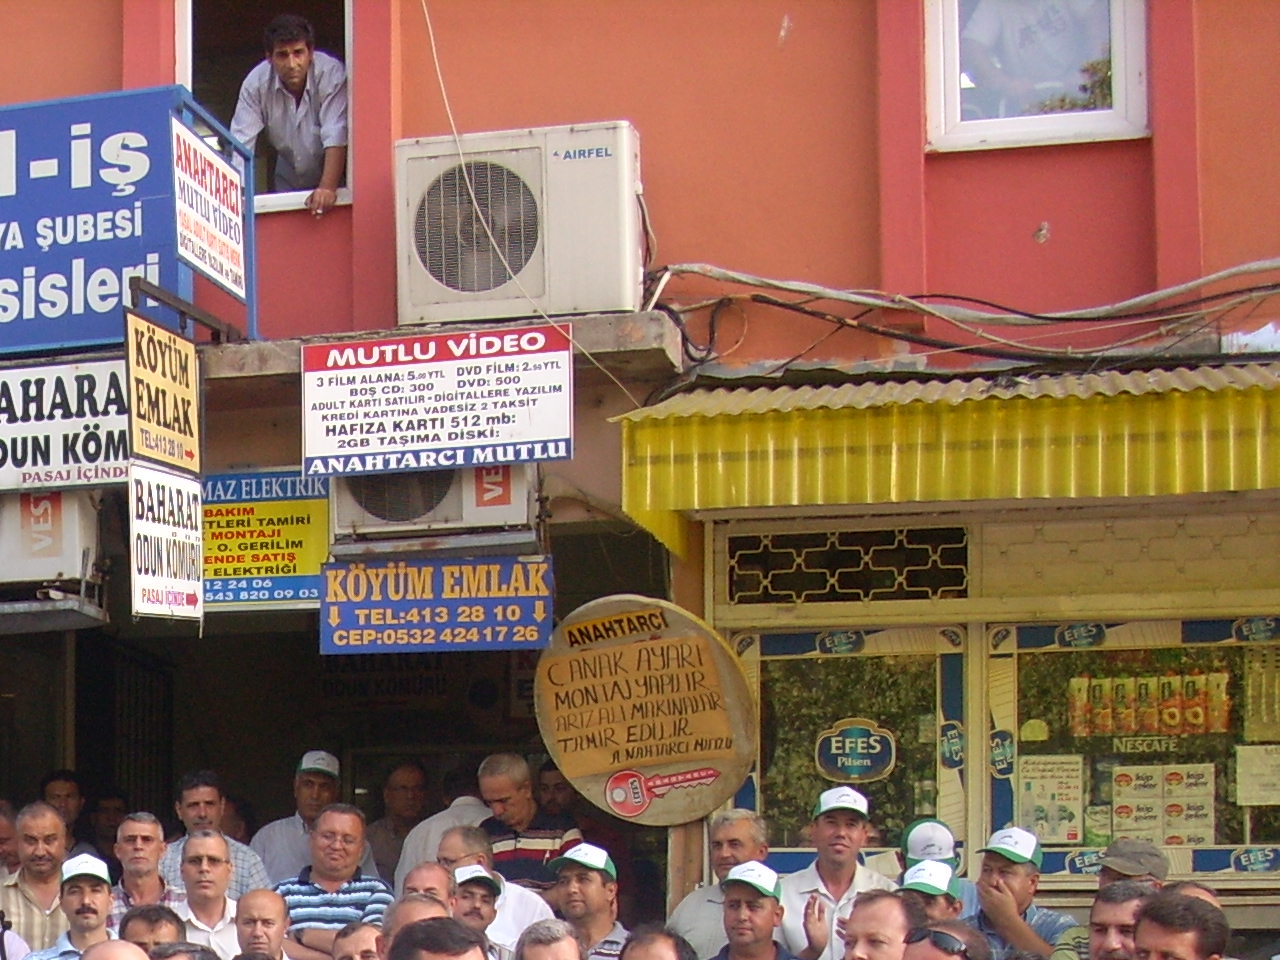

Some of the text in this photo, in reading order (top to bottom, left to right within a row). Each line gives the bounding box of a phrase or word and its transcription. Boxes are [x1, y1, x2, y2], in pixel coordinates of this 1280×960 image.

[562, 147, 612, 160] AIRFEL
[175, 133, 240, 218] ANAHTARCI
[36, 201, 142, 251] ŞUBESİ
[134, 324, 190, 389] KÖYÜM
[326, 332, 546, 368] MUTLU VİDEO
[316, 377, 324, 388] 3
[328, 372, 356, 387] FİLM
[457, 365, 482, 377] DVD
[311, 401, 346, 412] ADULT
[349, 397, 382, 409] KARTI
[384, 394, 426, 407] SATILIR
[515, 384, 563, 396] YAZILIM
[350, 387, 377, 399] BOŞ
[409, 383, 435, 393] 300
[134, 376, 194, 438] EMLAK
[321, 398, 538, 422] KREDİ KARTINA VADESİZ 2 TAKSİT
[325, 422, 387, 437] HAFIZA
[393, 418, 445, 433] KARTI
[450, 415, 482, 429] 512
[337, 437, 371, 449] 2GB
[376, 433, 442, 447] TAŞIMA
[308, 442, 567, 475] ANAHTARCI MUTLU
[22, 469, 71, 484] PASAJ
[134, 478, 200, 532] BAHARAT
[204, 507, 255, 518] BAKIM
[256, 514, 311, 527] TAMİRİ
[211, 529, 282, 541] MONTAJI
[238, 539, 304, 551] GERİLİM
[135, 532, 164, 578] ODUN
[251, 552, 297, 563] SATIŞ
[213, 563, 297, 577] ELEKTRİĞİ
[228, 580, 248, 590] 24
[252, 579, 273, 588] 06
[325, 561, 550, 603] KÖYÜM EMLAK
[141, 588, 164, 605] PASAJ
[240, 590, 269, 600] 820
[274, 589, 294, 599] 09
[298, 589, 319, 598] 03
[457, 605, 485, 623] 28
[493, 605, 521, 622] 10
[439, 627, 480, 643] 424
[482, 626, 508, 642] 17
[512, 625, 539, 642] 26
[567, 610, 669, 647] ANAHTARCI
[637, 643, 704, 671] AYARI
[830, 736, 883, 754] EFES
[1113, 736, 1179, 753] NESCAFÉ
[837, 756, 872, 768] Pilsen
[1240, 848, 1274, 866] EFES
